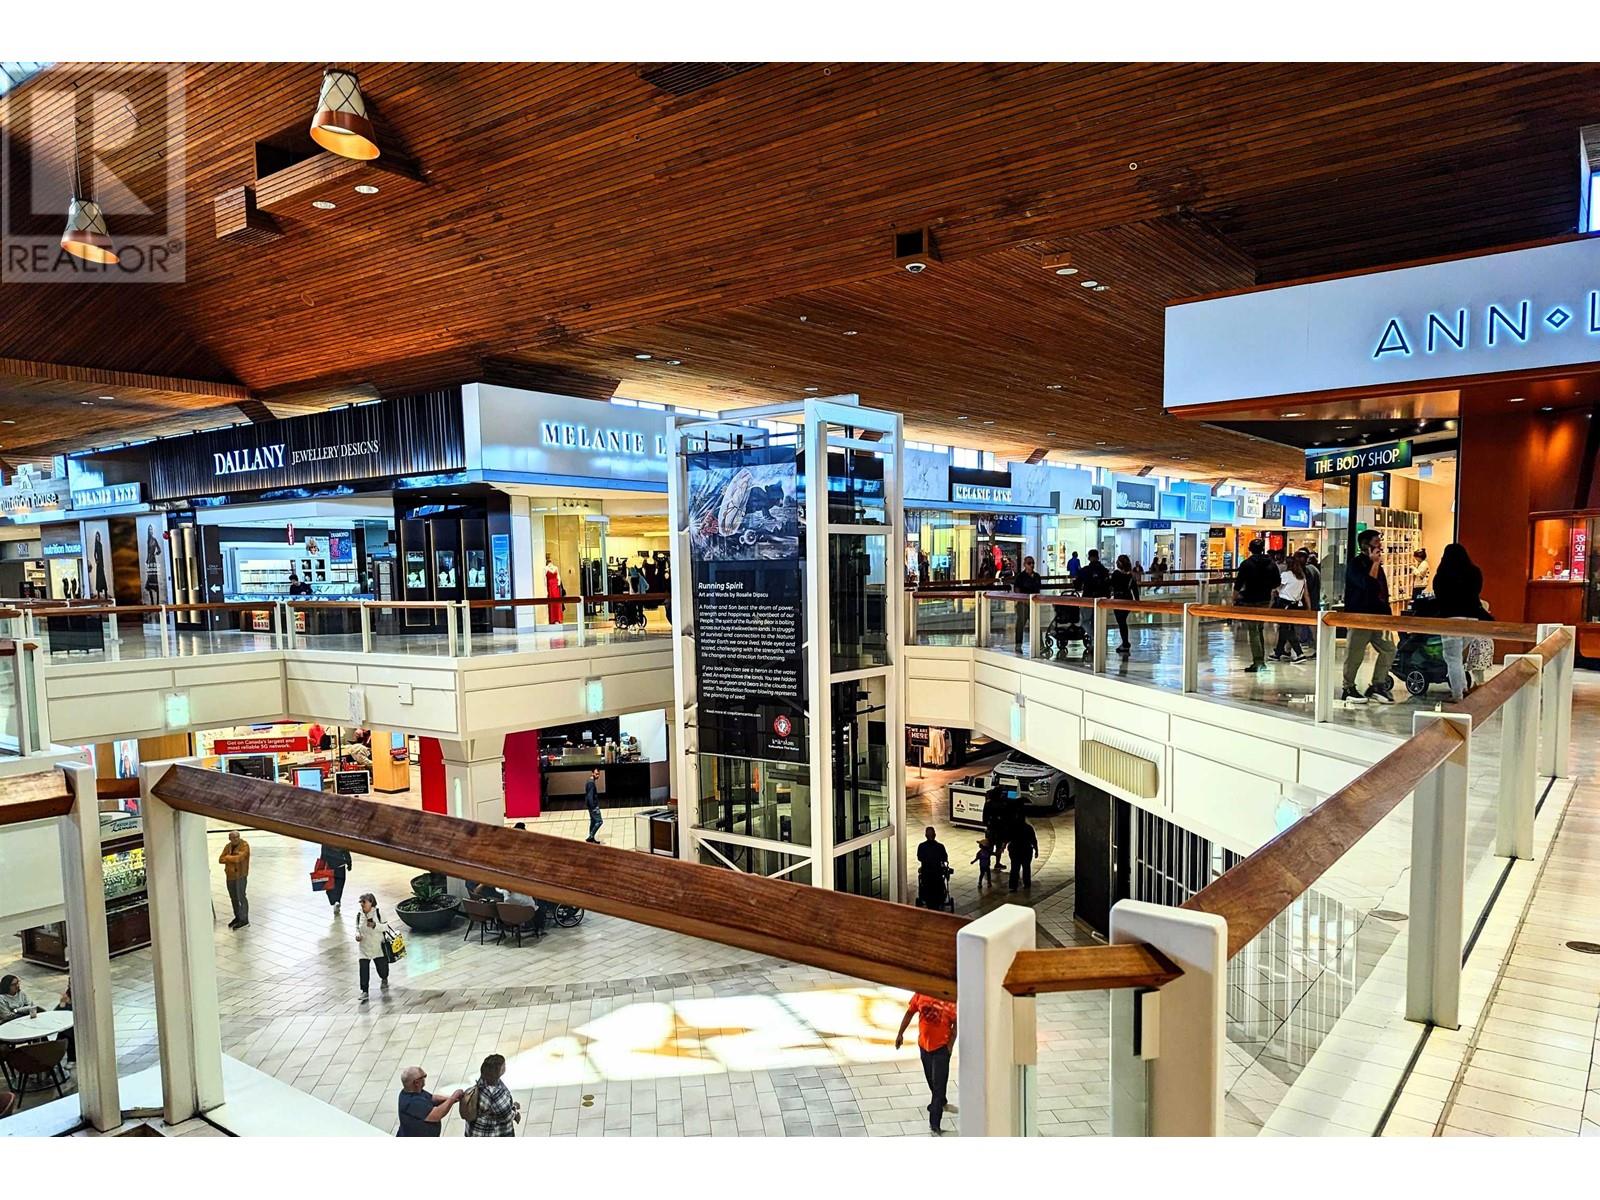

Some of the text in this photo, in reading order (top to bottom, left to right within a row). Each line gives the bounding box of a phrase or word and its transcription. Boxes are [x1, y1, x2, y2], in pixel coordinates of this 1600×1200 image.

[1373, 301, 1528, 358] ANN
[544, 423, 645, 453] MELANIE
[214, 440, 379, 476] DALLANY JEWELLERY DESIGNS
[1314, 460, 1334, 475] THE
[1336, 453, 1367, 471] BODY
[1074, 498, 1100, 511] ALDO
[1100, 519, 1123, 527] ALDO
[44, 542, 81, 555] nutrition house
[698, 582, 744, 591] Running Spirit
